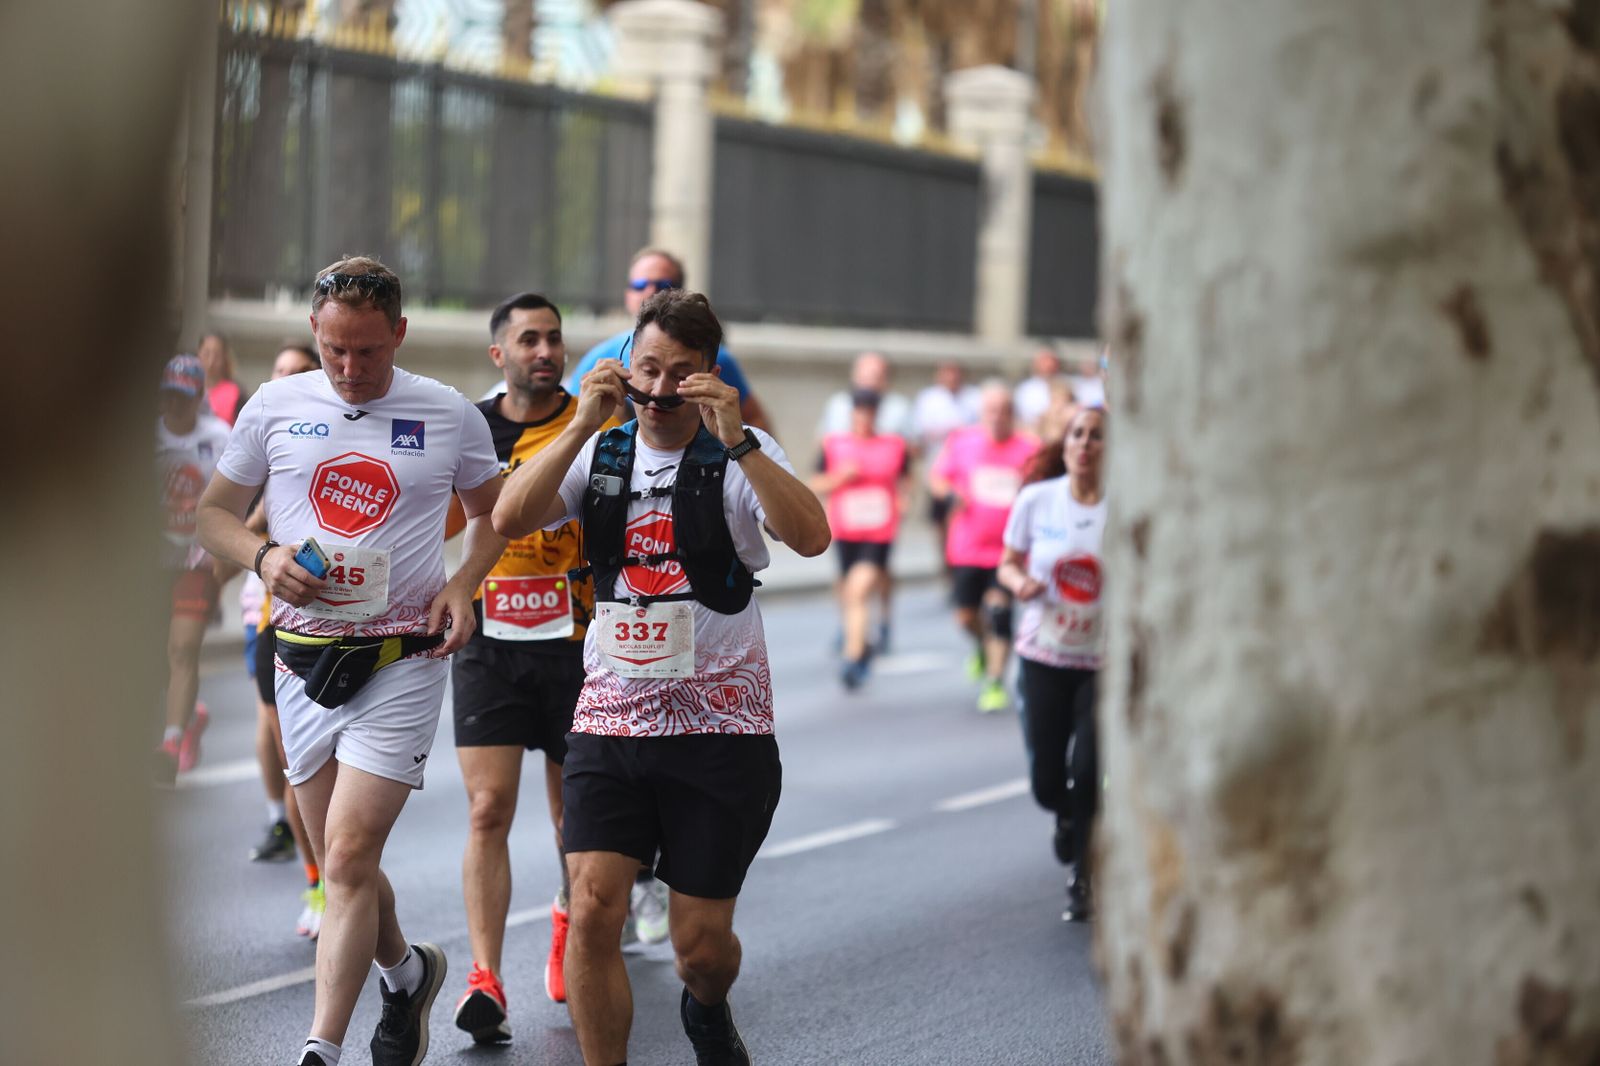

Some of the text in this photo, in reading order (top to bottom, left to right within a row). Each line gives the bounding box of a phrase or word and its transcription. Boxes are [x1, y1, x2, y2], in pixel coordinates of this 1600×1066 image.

[391, 434, 419, 447] AXA
[391, 449, 425, 458] fundación
[326, 470, 388, 504] PONLE
[320, 486, 380, 518] FRENO
[325, 565, 365, 586] 45
[495, 591, 559, 611] 2000
[615, 622, 669, 641] 337
